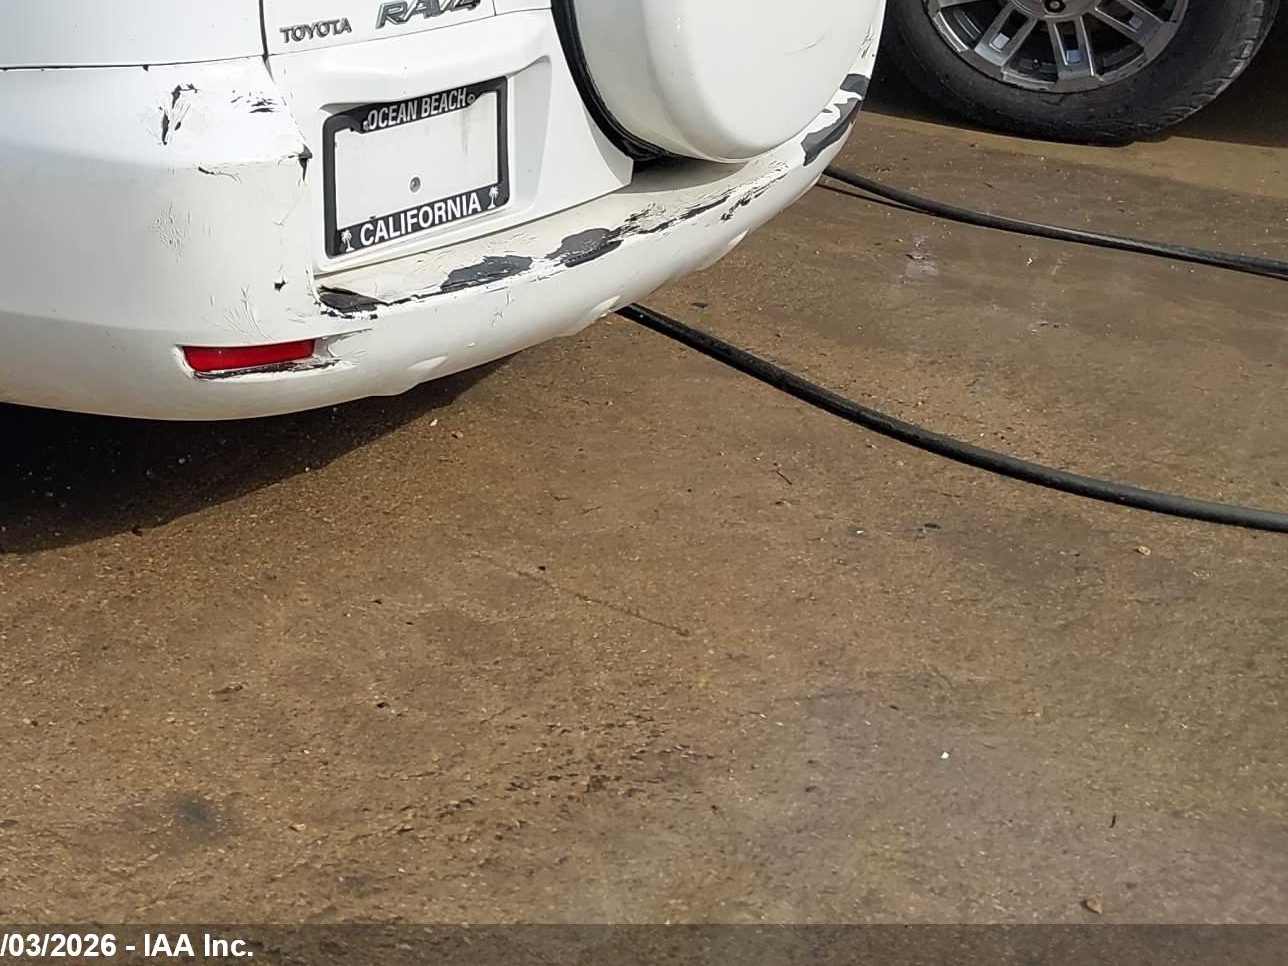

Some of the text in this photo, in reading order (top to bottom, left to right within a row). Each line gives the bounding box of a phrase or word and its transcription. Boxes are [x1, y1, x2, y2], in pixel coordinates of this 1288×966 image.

[280, 17, 352, 44] TOYOTA
[366, 88, 467, 131] OCEAN BEACH
[360, 192, 482, 247] CALIFORNIA
